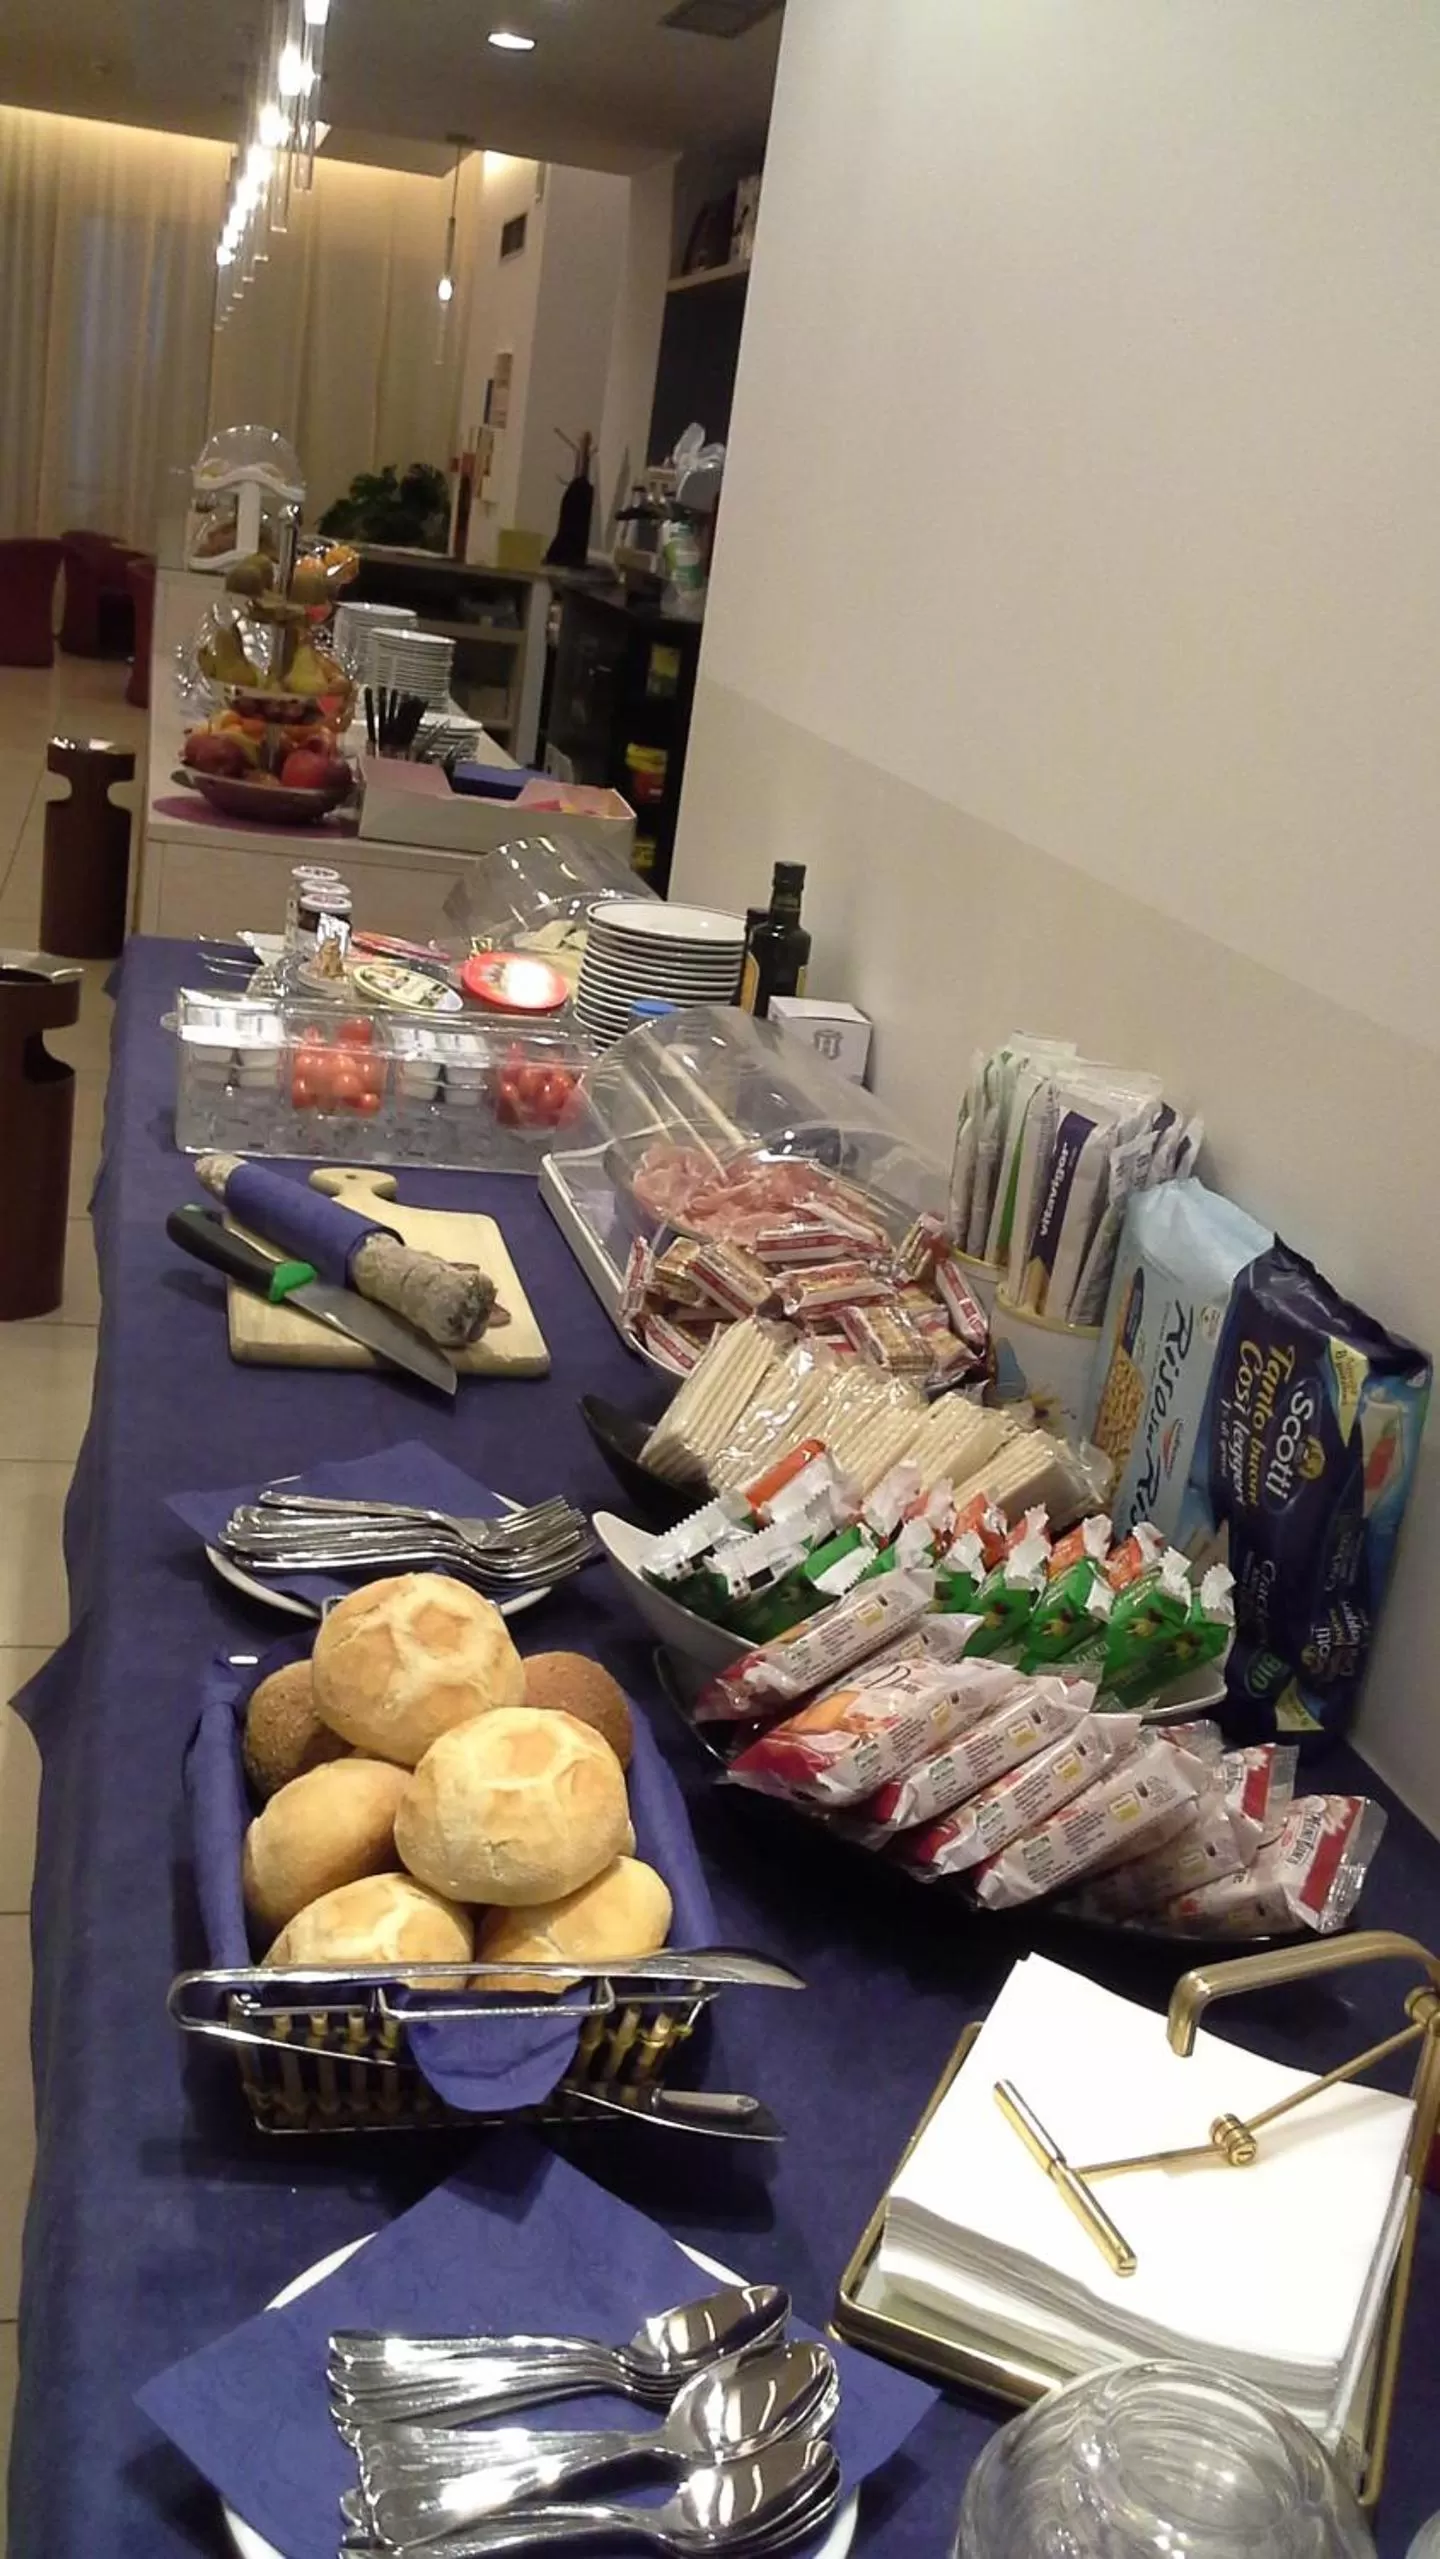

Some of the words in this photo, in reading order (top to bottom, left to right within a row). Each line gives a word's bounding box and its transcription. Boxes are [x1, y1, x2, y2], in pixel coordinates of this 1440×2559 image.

[1040, 1141, 1069, 1236] vitavigor
[1154, 1299, 1194, 1418] Riso
[1252, 1344, 1296, 1430] Tanto
[1265, 1390, 1315, 1500] Scotti
